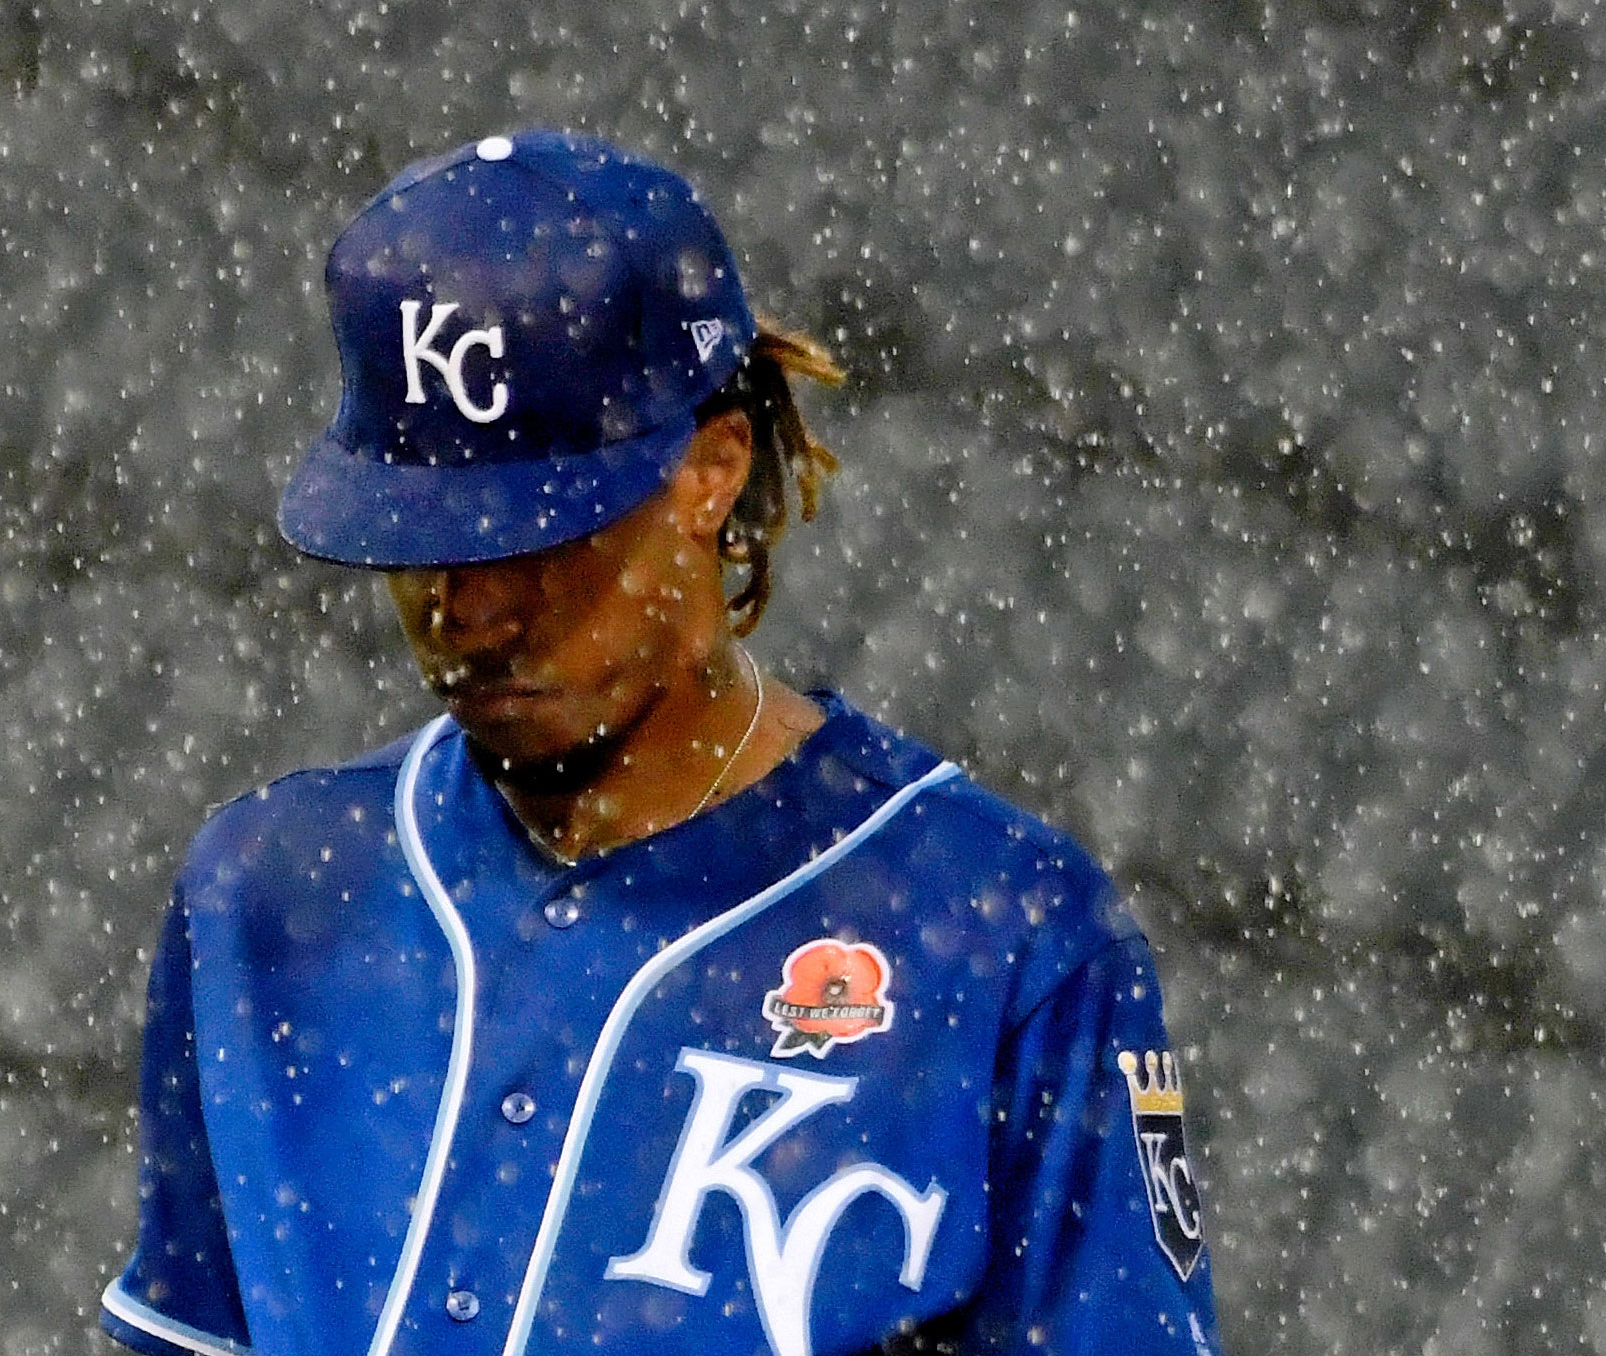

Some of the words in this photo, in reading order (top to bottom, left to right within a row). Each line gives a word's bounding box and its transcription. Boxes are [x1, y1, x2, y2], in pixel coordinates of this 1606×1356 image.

[400, 300, 508, 423] KC
[809, 1007, 829, 1019] WE
[1140, 1133, 1201, 1239] KC
